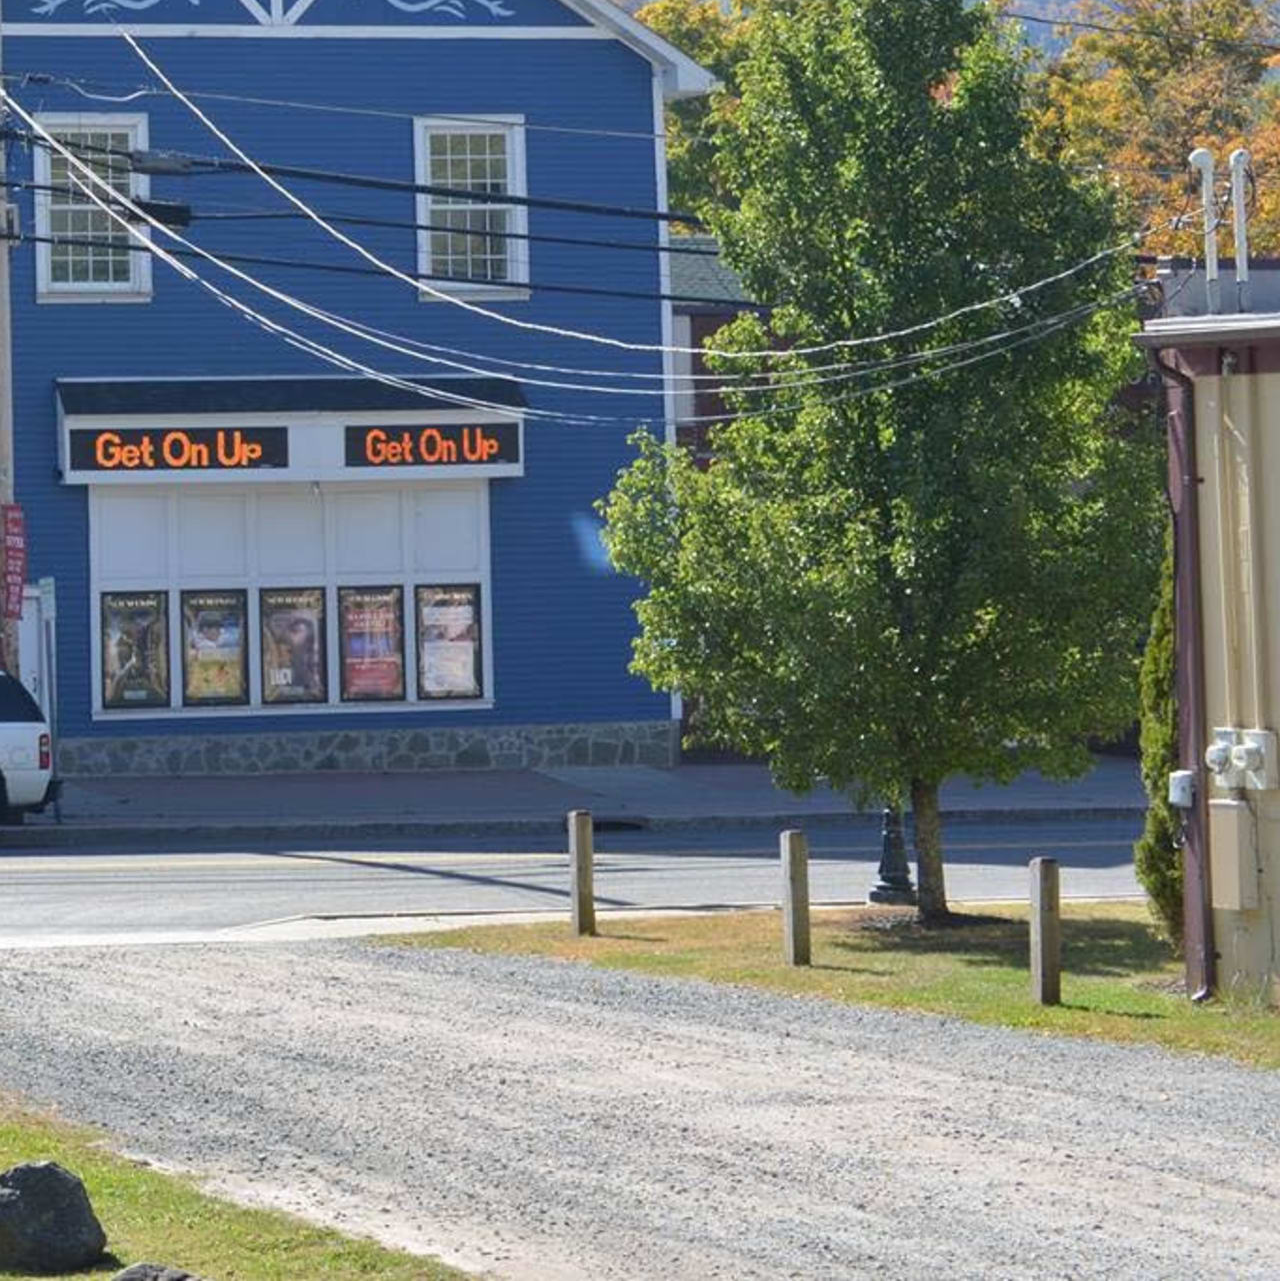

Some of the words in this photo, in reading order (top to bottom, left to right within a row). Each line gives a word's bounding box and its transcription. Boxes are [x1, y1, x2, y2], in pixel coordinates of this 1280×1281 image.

[95, 431, 155, 468] Get
[162, 430, 210, 467] On
[216, 430, 263, 467] Up
[365, 428, 414, 464] Get
[419, 428, 457, 463] On
[462, 427, 500, 461] Up
